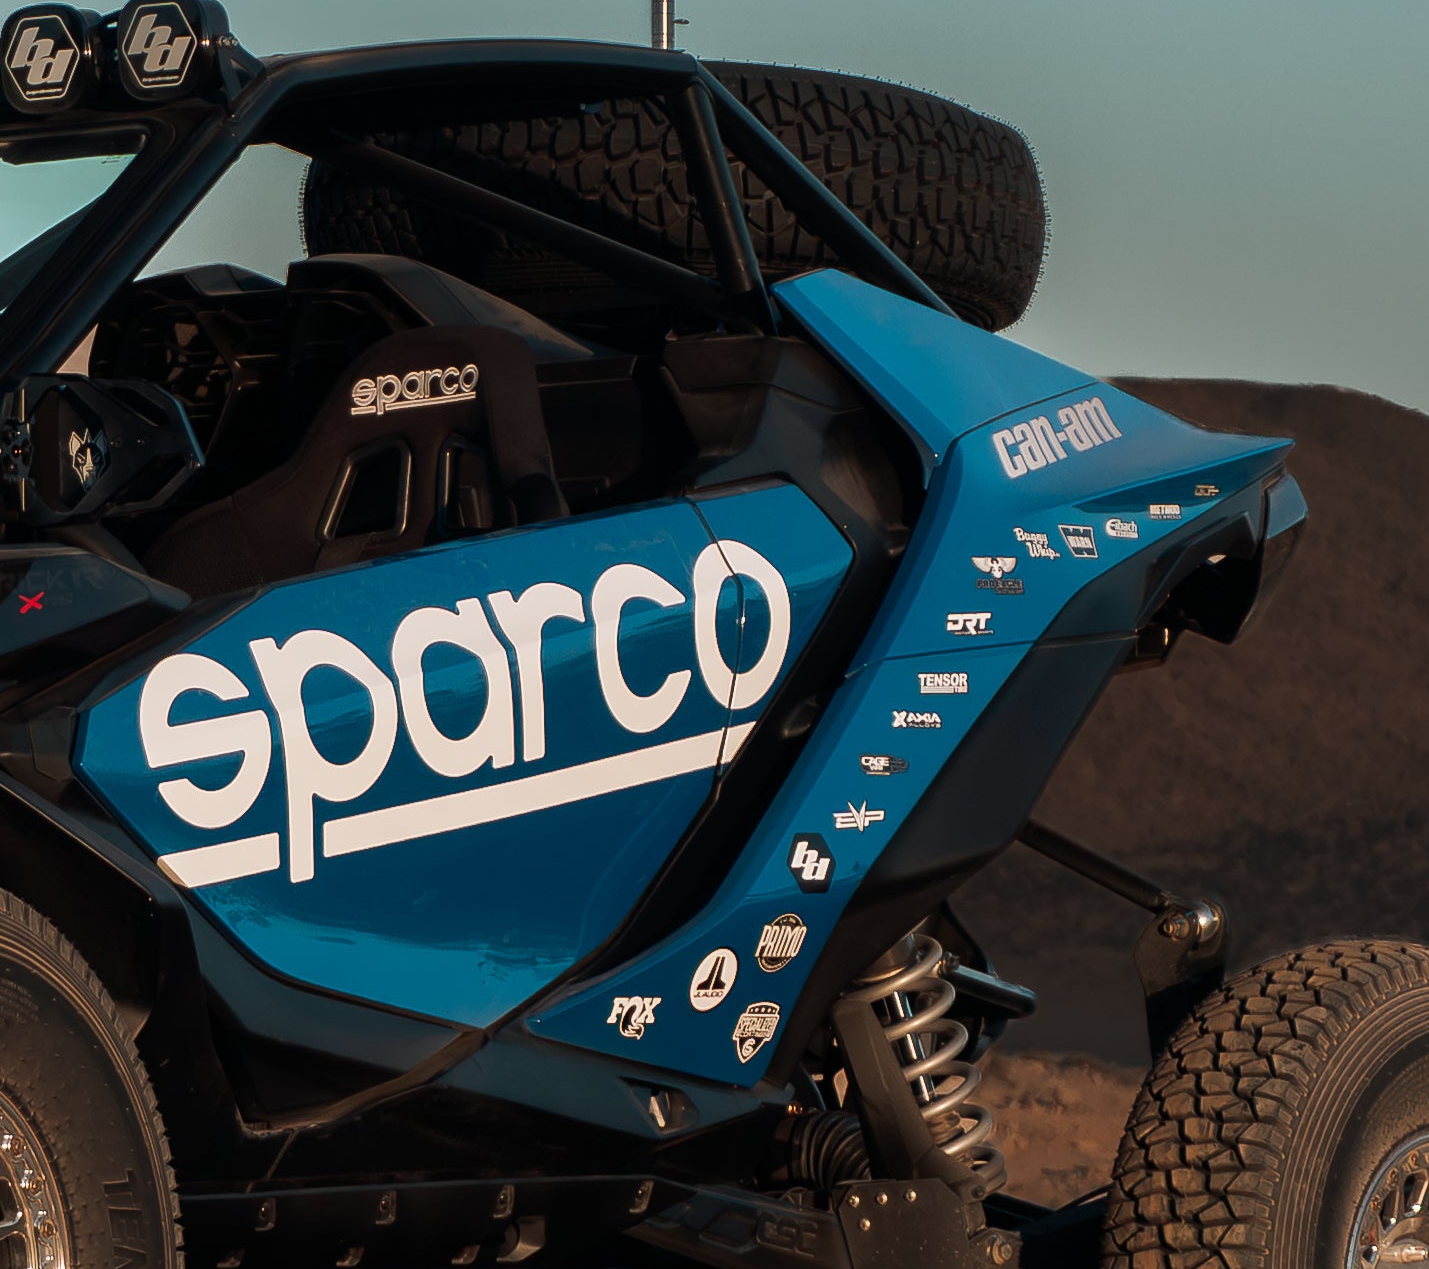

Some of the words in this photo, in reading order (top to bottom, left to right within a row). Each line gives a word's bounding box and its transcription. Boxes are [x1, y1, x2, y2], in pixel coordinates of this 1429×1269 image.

[351, 364, 479, 415] sparco
[992, 396, 1123, 479] can-am
[918, 673, 968, 687] TENSOR
[140, 539, 791, 885] sparco
[755, 925, 808, 958] PRIMO
[607, 996, 662, 1032] FOX
